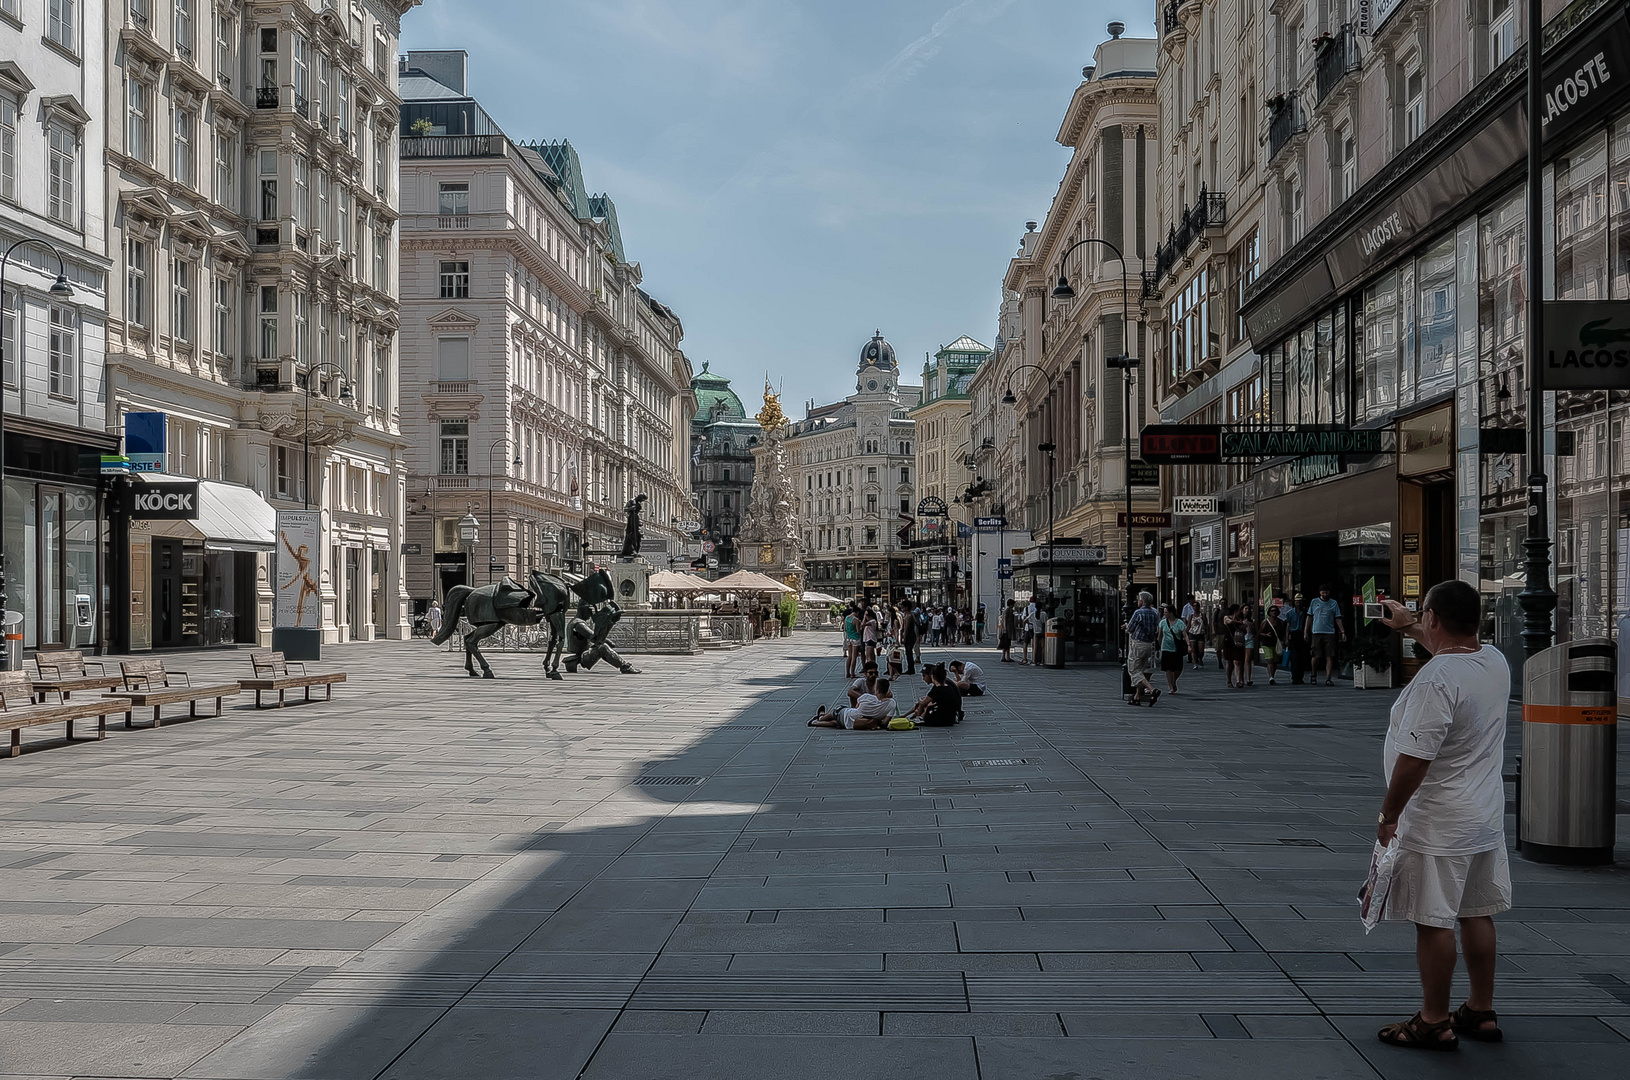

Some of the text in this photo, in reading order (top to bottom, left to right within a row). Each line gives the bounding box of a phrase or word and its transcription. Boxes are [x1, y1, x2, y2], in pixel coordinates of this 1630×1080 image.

[1361, 211, 1403, 256] LACOSTE
[1549, 349, 1630, 368] LACOS
[1147, 436, 1214, 452] LLOYD
[1224, 431, 1382, 455] SALAMANDER
[135, 490, 193, 511] KÖCK
[1182, 502, 1211, 511] Wolford
[978, 518, 1002, 526] Berlitz
[1052, 549, 1096, 558] OUVENIRS
